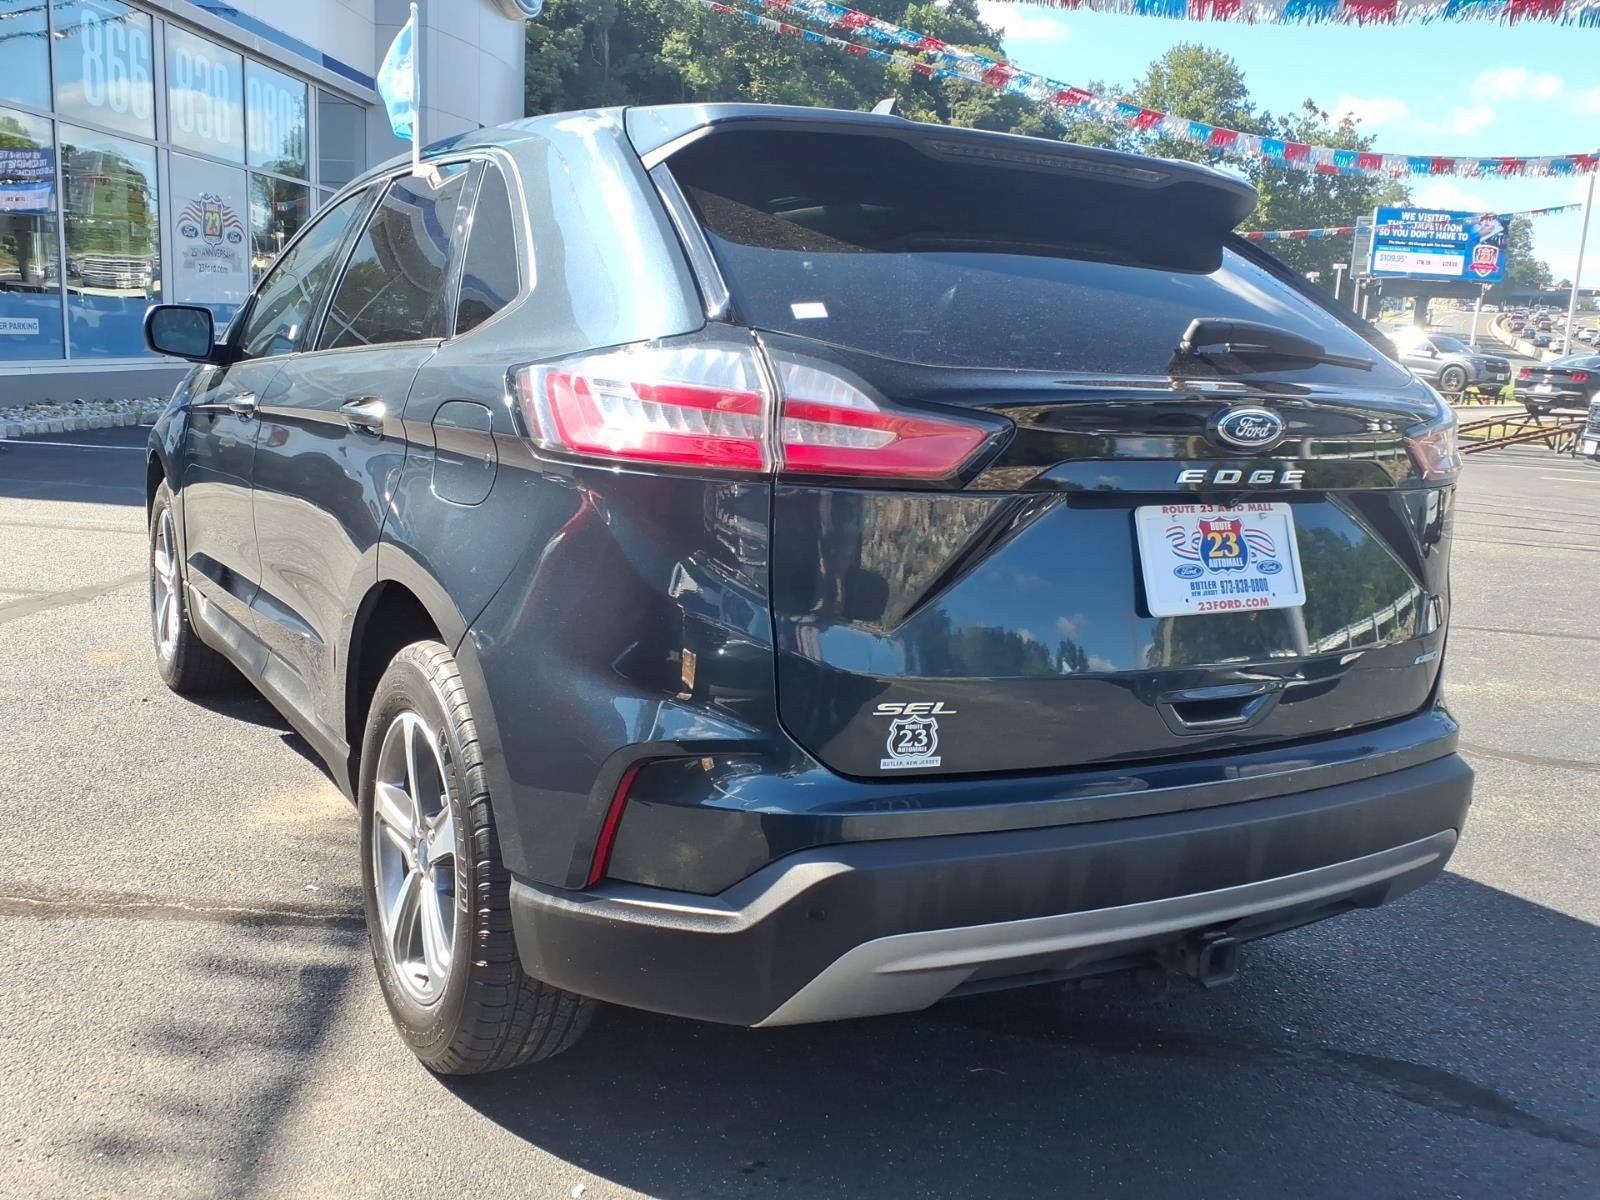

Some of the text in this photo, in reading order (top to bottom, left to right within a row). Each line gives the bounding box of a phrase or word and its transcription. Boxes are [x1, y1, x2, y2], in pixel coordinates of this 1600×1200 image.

[80, 9, 149, 120] 866
[176, 47, 231, 143] 838
[1401, 212, 1451, 222] WE VISITED
[1379, 228, 1468, 241] SO YOU DON'T HAVE TO
[9, 321, 38, 330] PARKING
[1235, 416, 1270, 438] Ford
[1176, 469, 1306, 484] EDGE
[1162, 505, 1196, 514] ROUTE
[1200, 504, 1214, 513] 23
[1248, 503, 1274, 512] MALL
[1209, 521, 1232, 531] ROUTE
[1207, 531, 1240, 557] 23
[1209, 557, 1244, 569] AUTOMALL
[1190, 578, 1269, 594] BUTLER 973-838-0800
[1198, 597, 1270, 611] 23FORD.COM
[873, 702, 957, 716] SEL
[898, 729, 928, 747] 23
